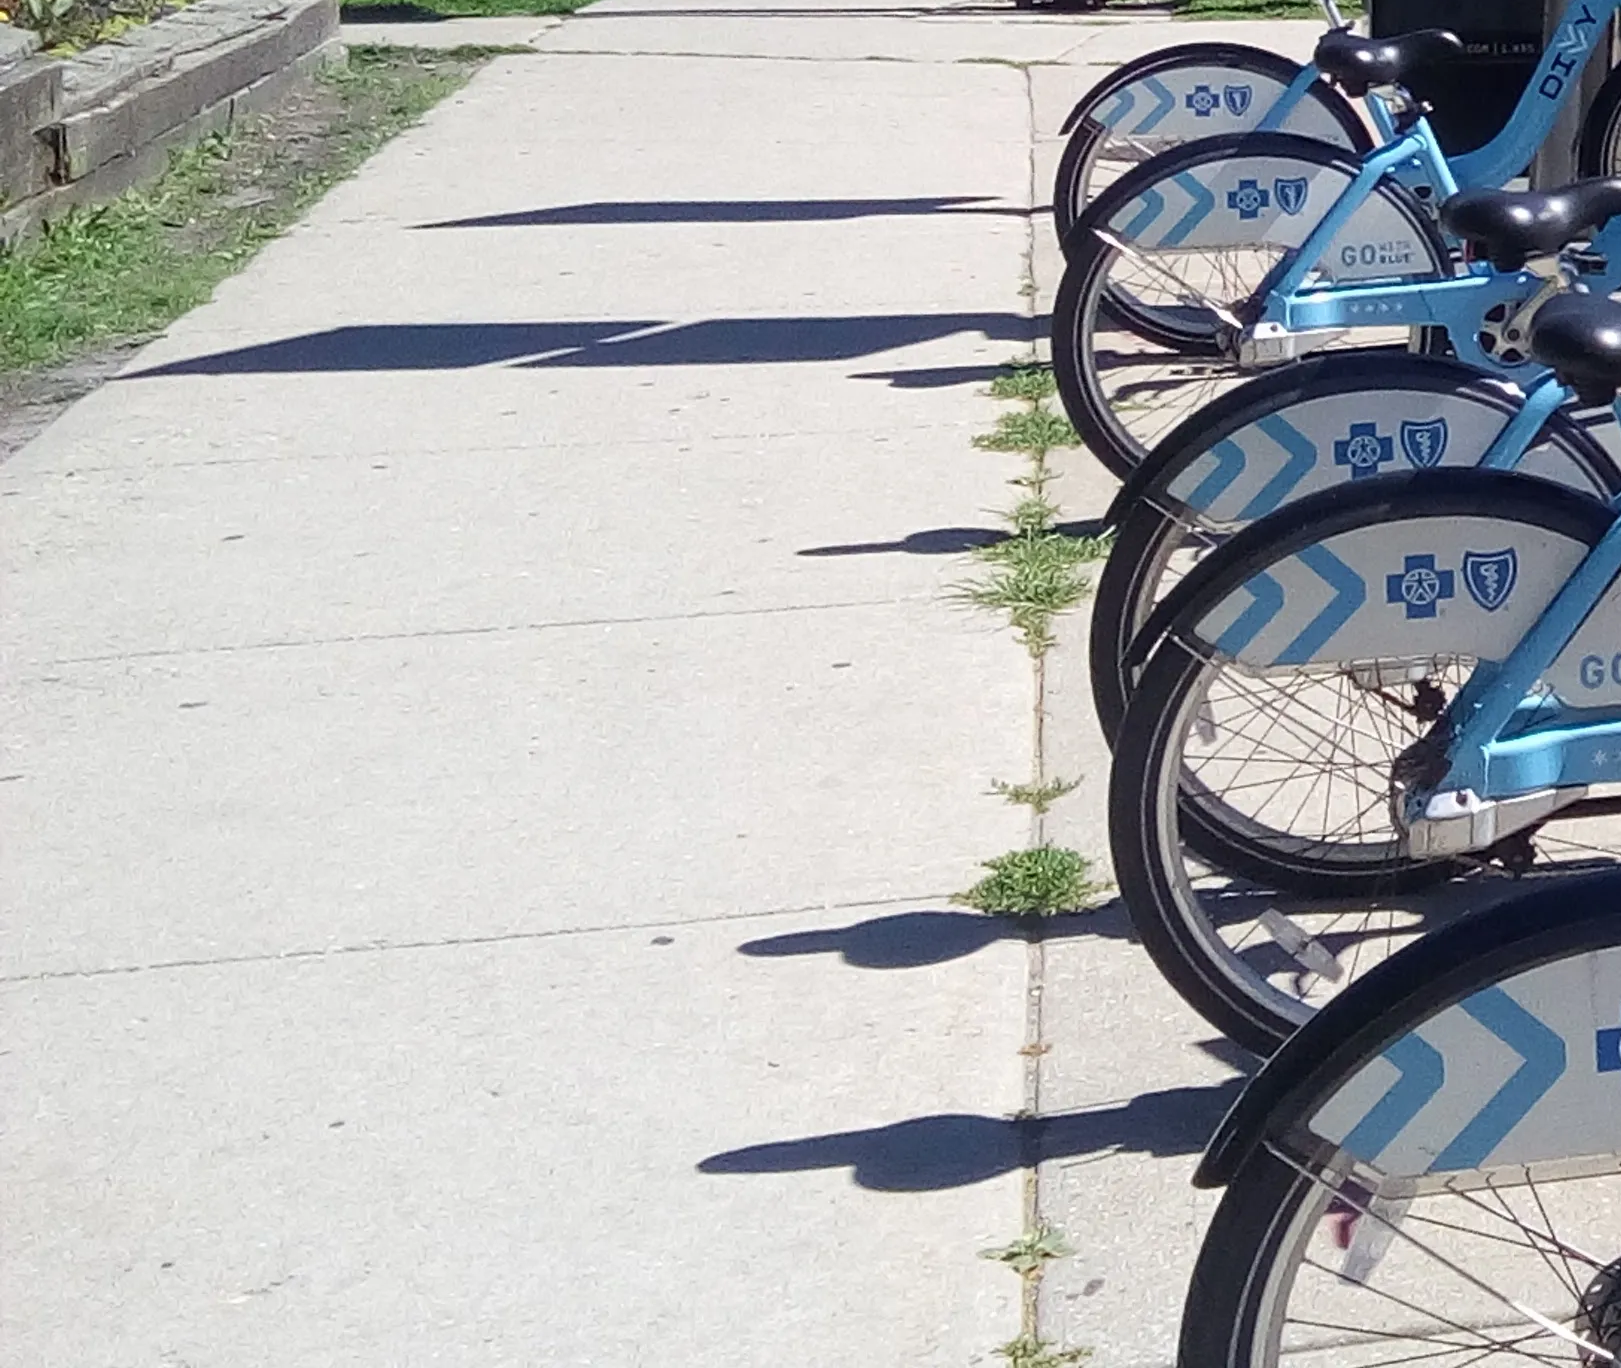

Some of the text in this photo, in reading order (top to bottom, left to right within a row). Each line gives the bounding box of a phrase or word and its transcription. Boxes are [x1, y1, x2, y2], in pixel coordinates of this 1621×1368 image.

[1341, 240, 1411, 268] GO WITH
[1379, 253, 1411, 264] BLUE
